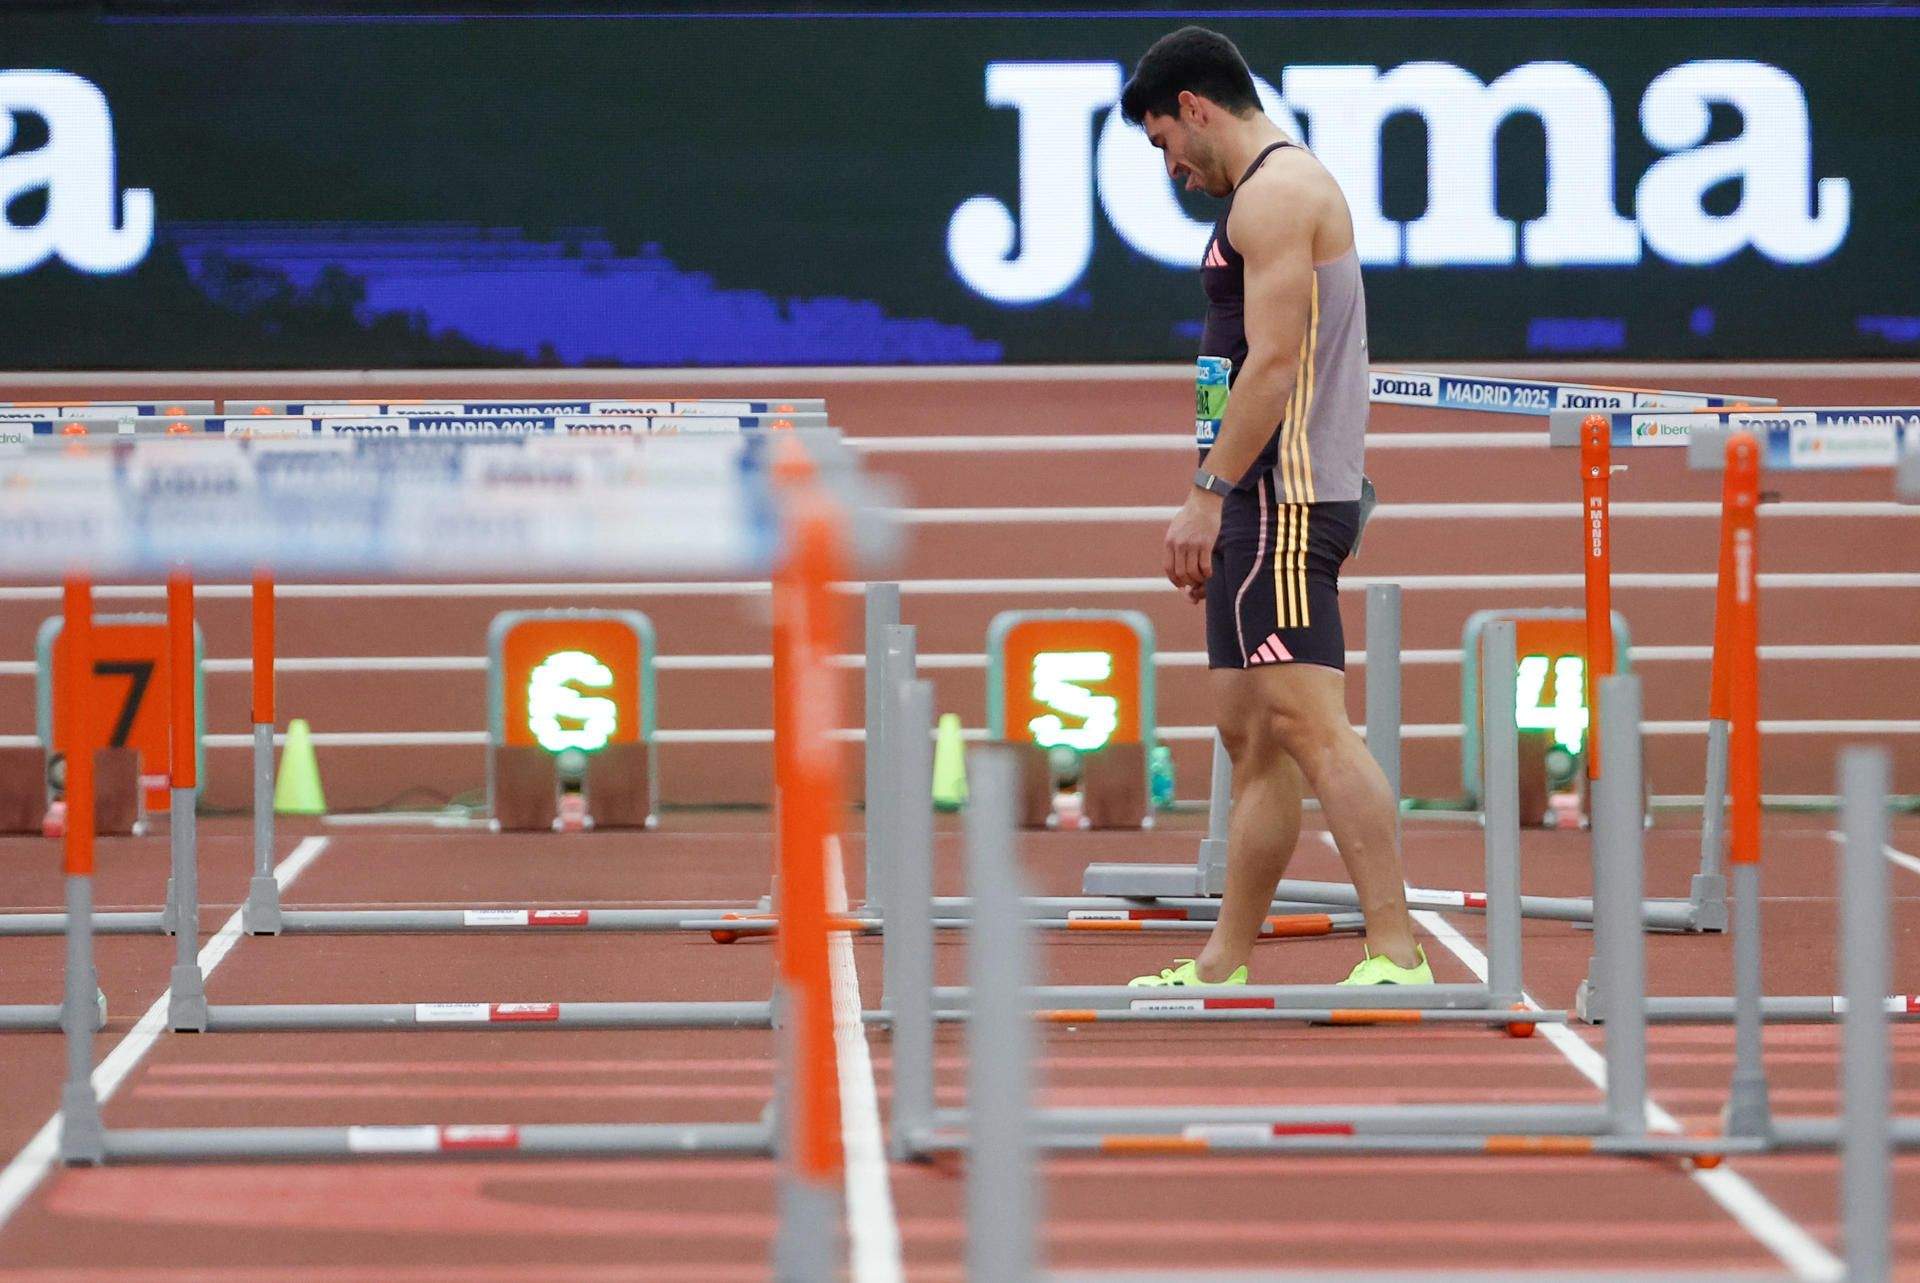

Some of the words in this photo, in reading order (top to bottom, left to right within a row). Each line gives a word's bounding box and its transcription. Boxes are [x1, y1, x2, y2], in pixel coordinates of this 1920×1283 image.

[945, 59, 1851, 305] Joma
[1372, 378, 1432, 397] Joma
[1446, 382, 1511, 406] MADRID
[1513, 388, 1549, 410] 2025
[93, 660, 155, 749] 7
[528, 651, 617, 751] 6
[1029, 651, 1117, 750] 5
[1515, 655, 1590, 755] 4
